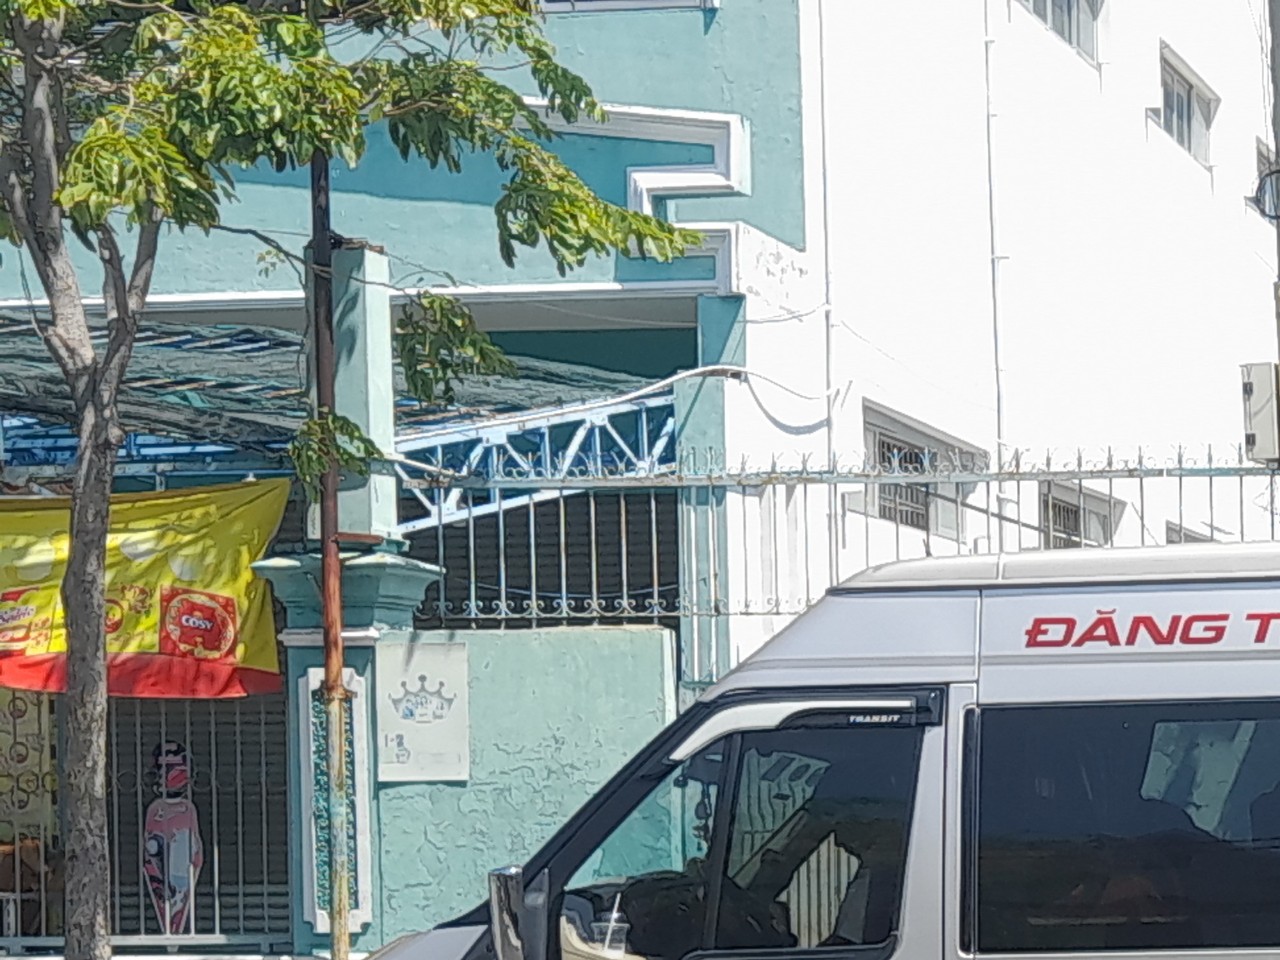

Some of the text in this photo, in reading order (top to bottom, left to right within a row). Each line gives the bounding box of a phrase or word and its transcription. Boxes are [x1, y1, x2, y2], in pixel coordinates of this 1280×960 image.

[180, 613, 215, 630] COSY
[1024, 608, 1231, 649] ĐĂNG
[848, 714, 901, 723] TRANSIT
